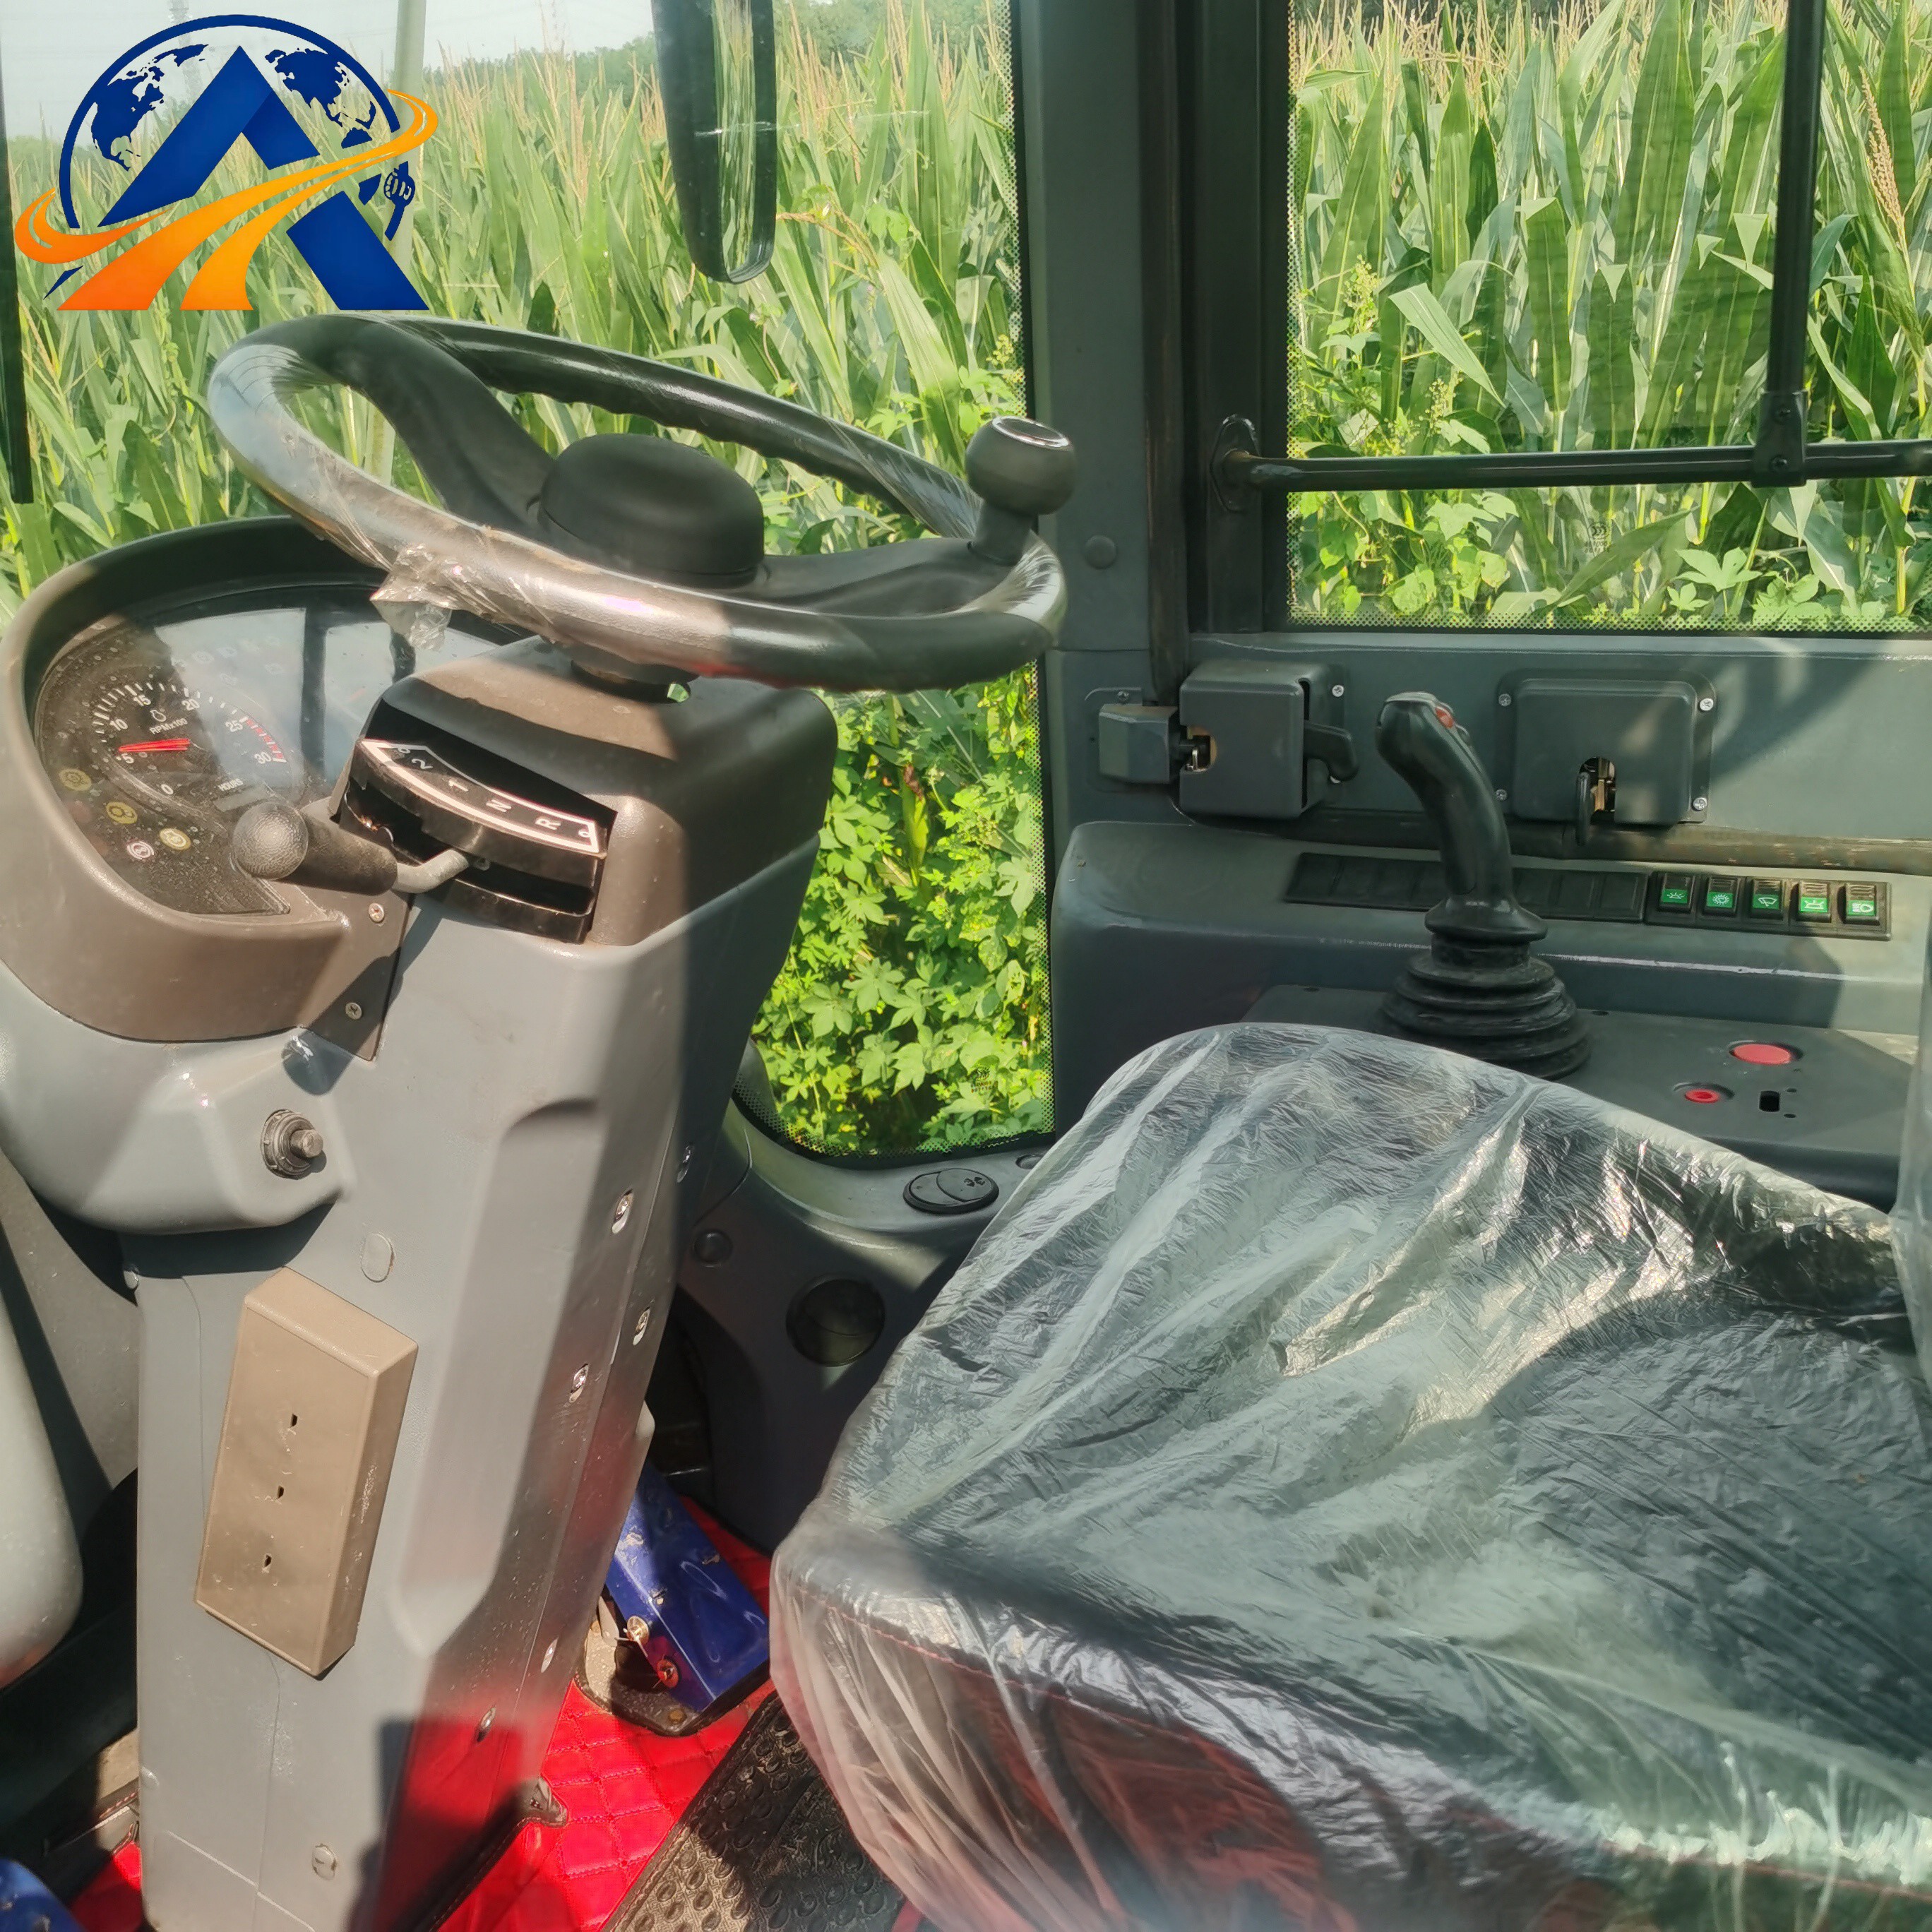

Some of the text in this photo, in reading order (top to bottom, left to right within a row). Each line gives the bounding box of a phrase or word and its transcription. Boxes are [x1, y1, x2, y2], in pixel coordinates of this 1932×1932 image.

[133, 695, 151, 706] 15
[181, 698, 200, 710] 20
[110, 718, 128, 731] 10
[149, 717, 188, 735] RPMx100
[225, 720, 244, 733] 25
[121, 753, 134, 764] 5
[254, 751, 272, 764] 30
[411, 758, 434, 770] 2
[160, 783, 174, 795] 0
[218, 777, 244, 792] HOURS
[448, 777, 469, 792] 1
[486, 799, 512, 813] N
[535, 816, 561, 830] R
